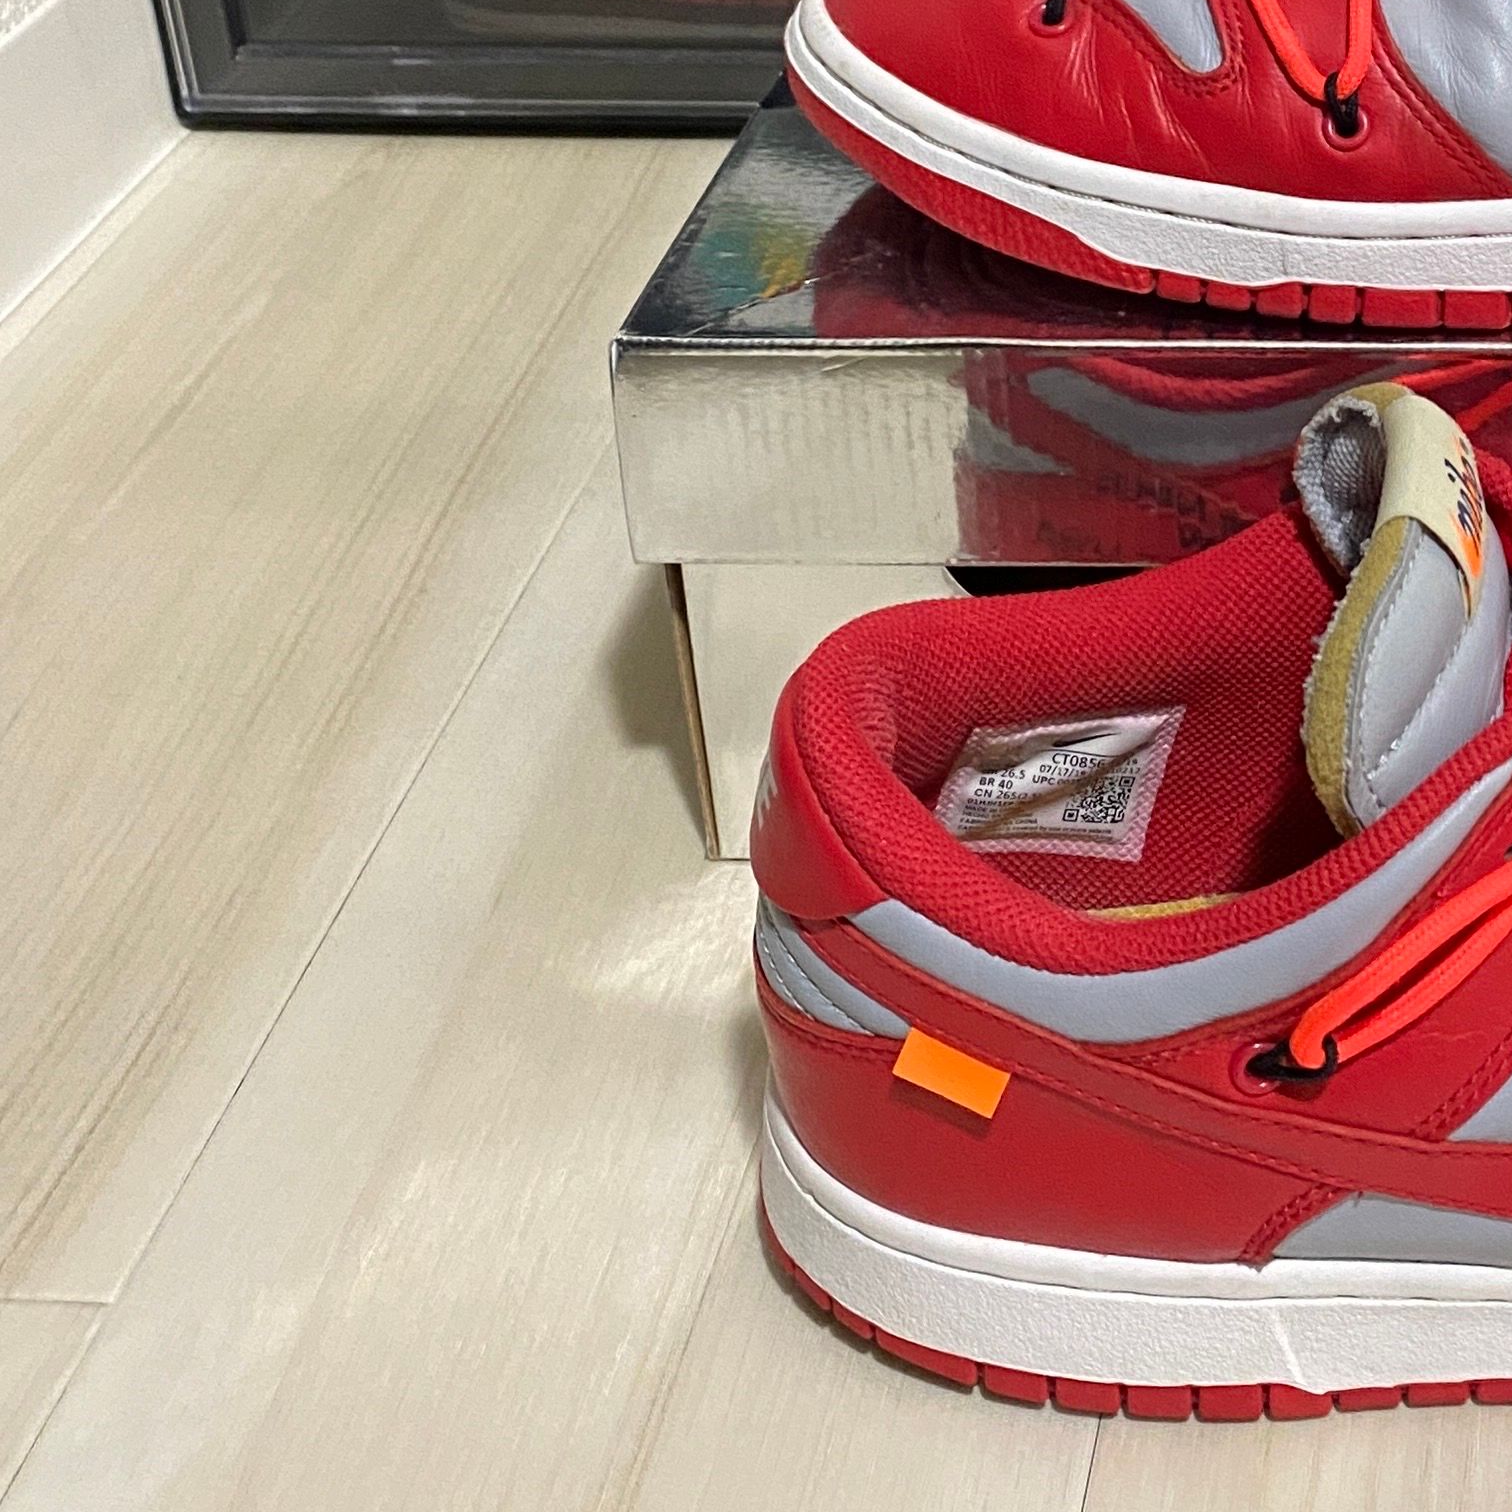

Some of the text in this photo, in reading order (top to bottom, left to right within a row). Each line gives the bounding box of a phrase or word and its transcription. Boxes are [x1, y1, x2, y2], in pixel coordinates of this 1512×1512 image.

[979, 776, 1014, 790] BR 40
[1032, 774, 1055, 786] UPC
[974, 788, 993, 798] CN
